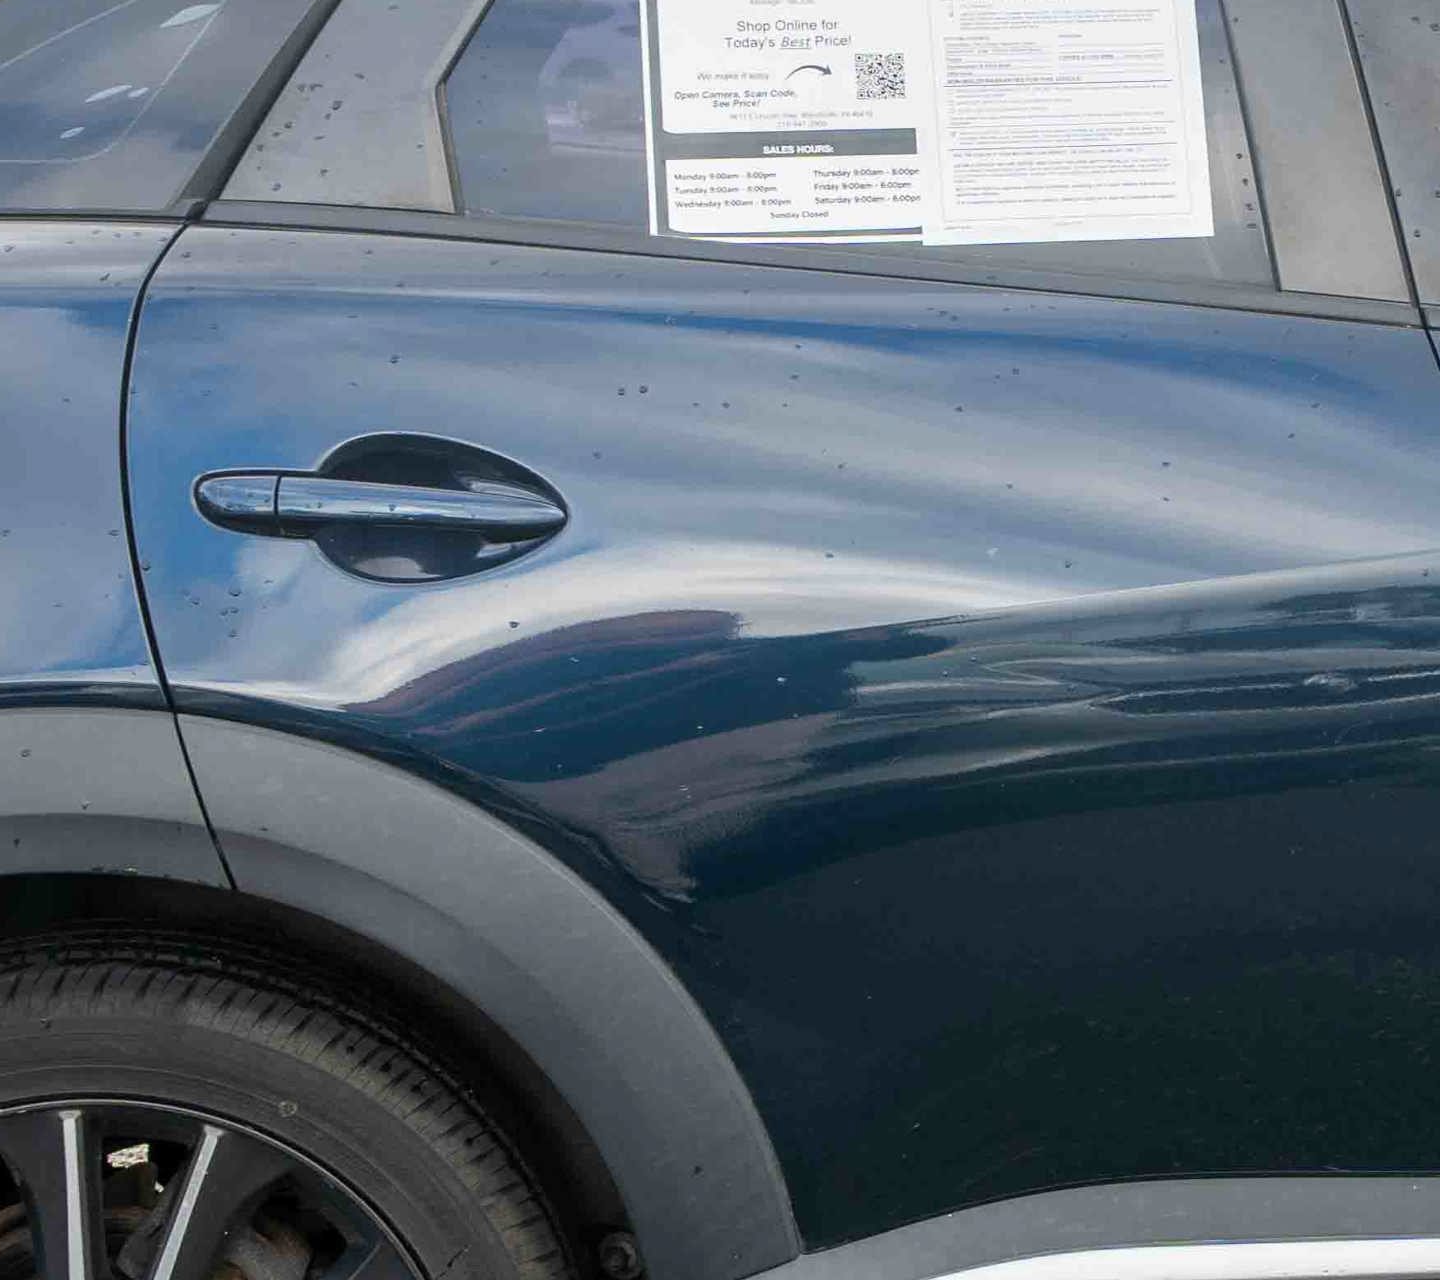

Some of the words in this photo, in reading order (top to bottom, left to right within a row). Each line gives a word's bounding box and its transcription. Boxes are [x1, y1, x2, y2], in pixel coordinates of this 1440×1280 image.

[736, 20, 771, 33] Shop
[774, 19, 817, 31] Online
[821, 19, 839, 31] for
[724, 36, 775, 50] Today's
[781, 37, 811, 49] Best
[814, 35, 852, 47] Price!
[673, 91, 700, 101] Open
[743, 90, 768, 99] Scan
[762, 145, 795, 154] SALES
[673, 173, 706, 182] Monday
[813, 169, 851, 178] Thursday
[813, 182, 839, 191] Friday
[675, 200, 722, 209] Wednesday
[814, 195, 852, 205] Saturday
[801, 210, 830, 218] Closed
